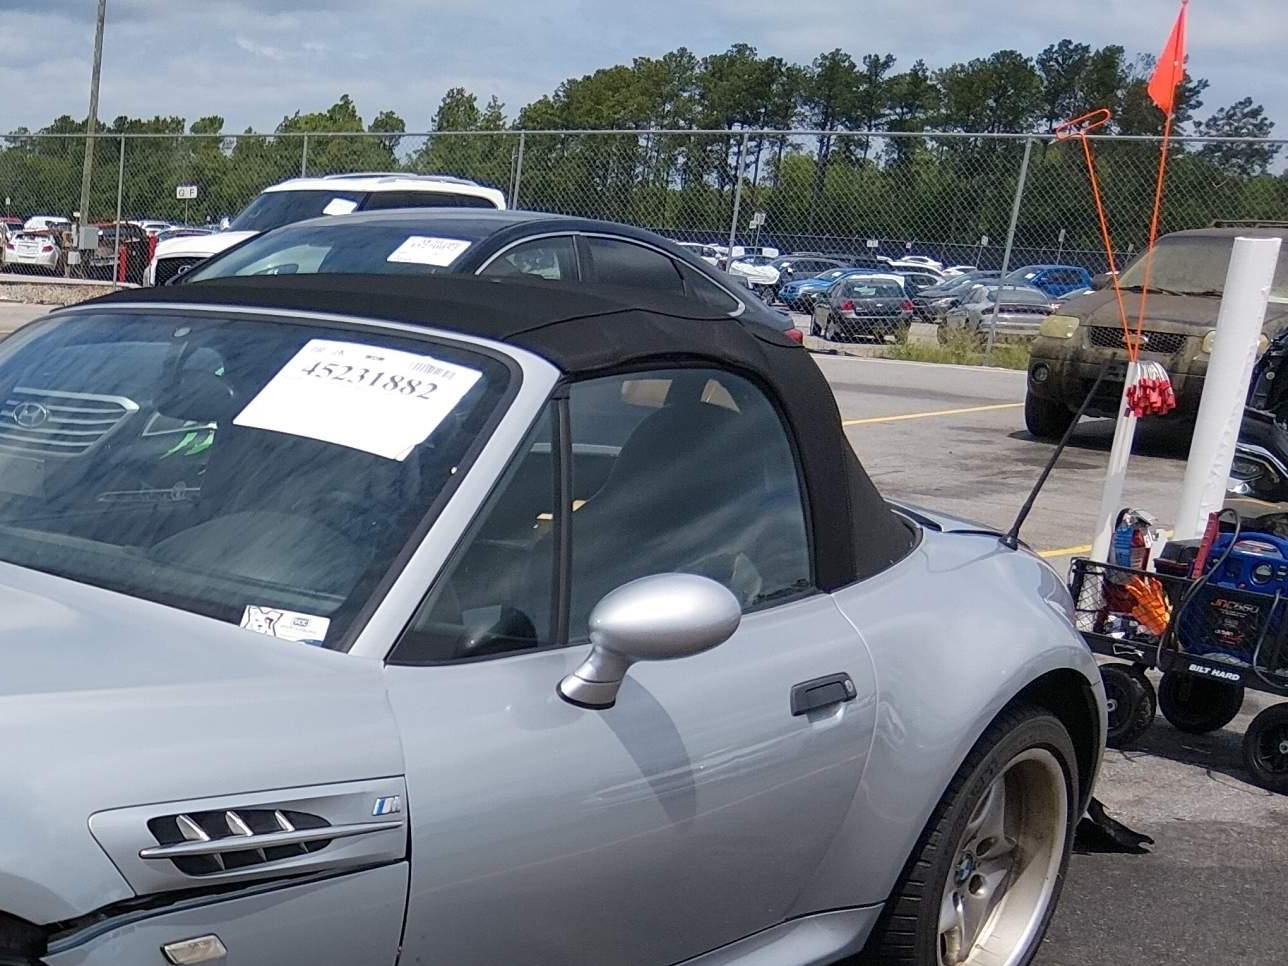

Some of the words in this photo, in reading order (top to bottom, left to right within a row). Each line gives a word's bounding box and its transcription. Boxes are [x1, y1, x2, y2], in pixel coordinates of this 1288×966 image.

[301, 361, 438, 400] 45231882
[1189, 664, 1211, 674] BILT
[1211, 669, 1240, 681] HARD
